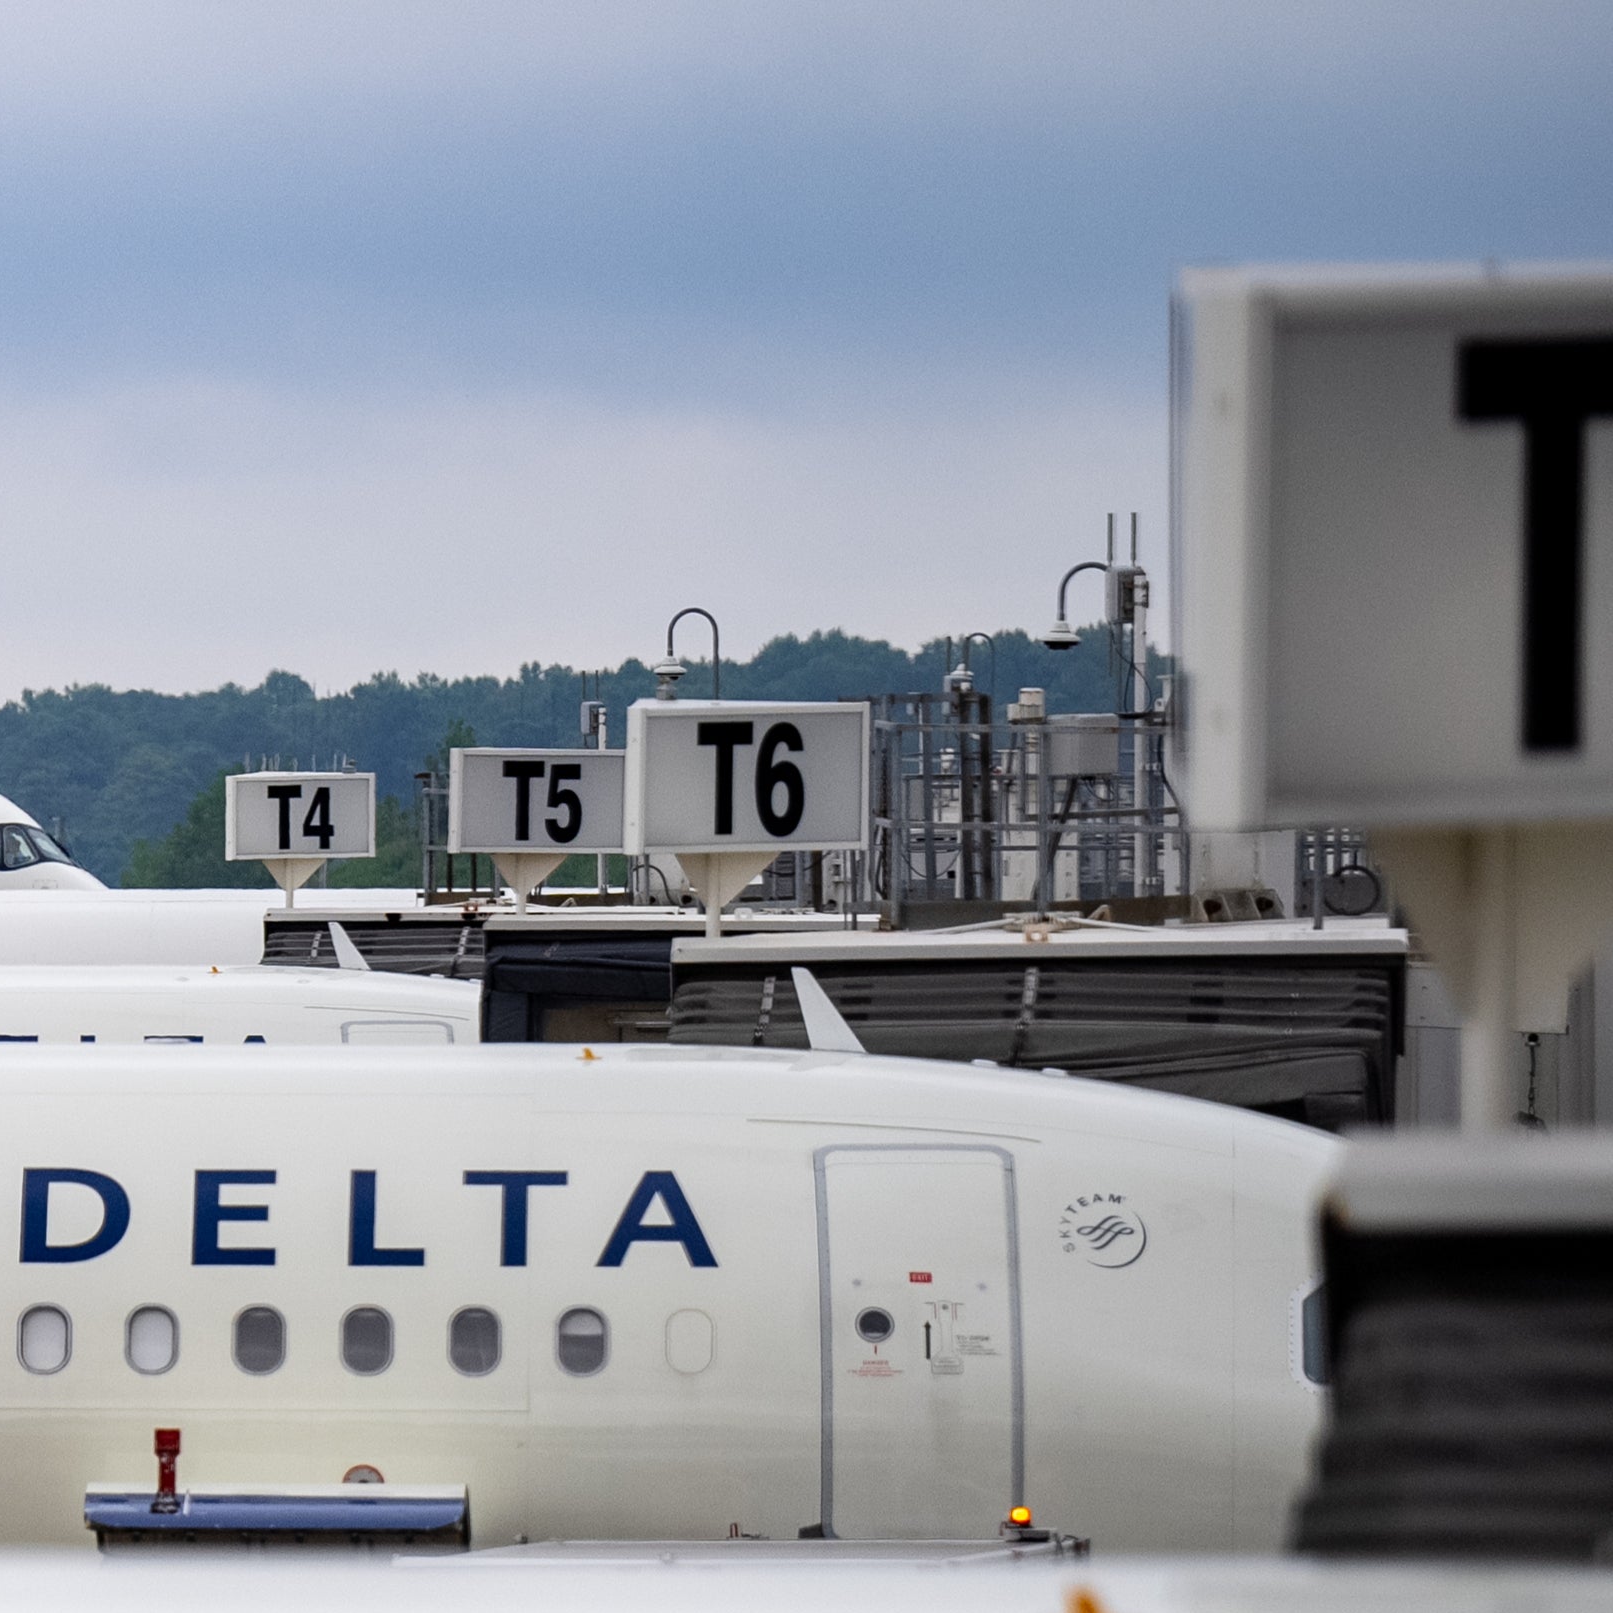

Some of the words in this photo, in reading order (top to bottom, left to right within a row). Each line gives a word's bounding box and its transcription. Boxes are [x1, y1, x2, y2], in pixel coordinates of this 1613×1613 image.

[267, 784, 335, 850] T4
[501, 759, 583, 844] T5
[697, 720, 805, 838] T6
[18, 1166, 720, 1269] DELTA
[1058, 1193, 1123, 1254] SKYTEAM
